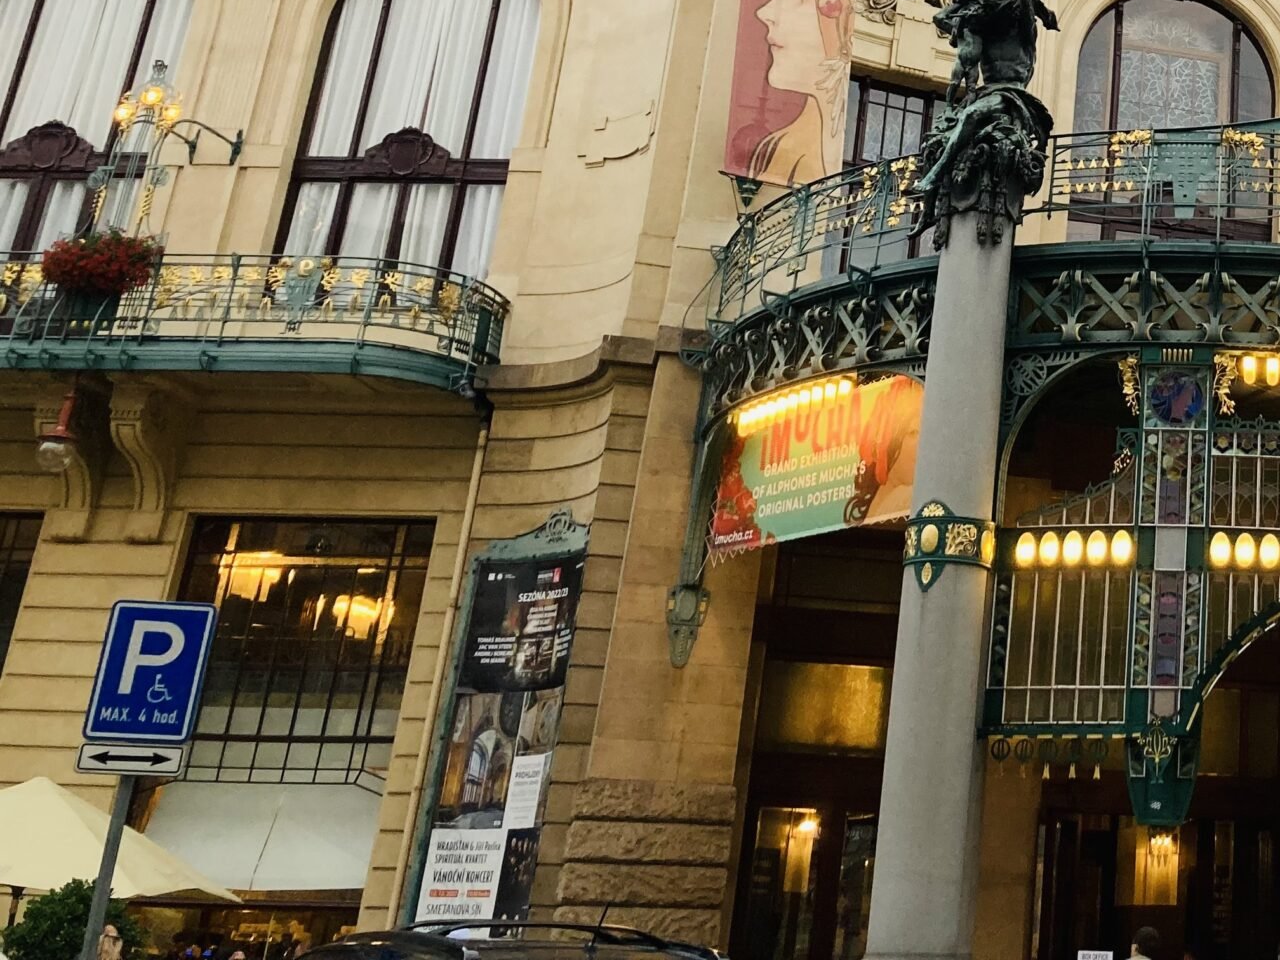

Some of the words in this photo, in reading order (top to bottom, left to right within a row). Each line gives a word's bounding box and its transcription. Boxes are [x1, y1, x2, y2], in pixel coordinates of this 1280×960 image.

[763, 457, 798, 478] GRAND
[800, 442, 857, 466] EXHIBITION
[752, 484, 766, 499] OF
[766, 472, 817, 496] ALPHONSE
[819, 460, 866, 483] MUCHA'S
[758, 495, 804, 518] ORIGINAL
[715, 530, 754, 544] imucha.cz
[117, 619, 186, 695] P
[99, 707, 131, 722] MAX.
[138, 708, 146, 723] 4
[152, 709, 179, 724] hod.
[465, 870, 494, 883] KONCERT
[425, 903, 470, 915] SMETANOVA
